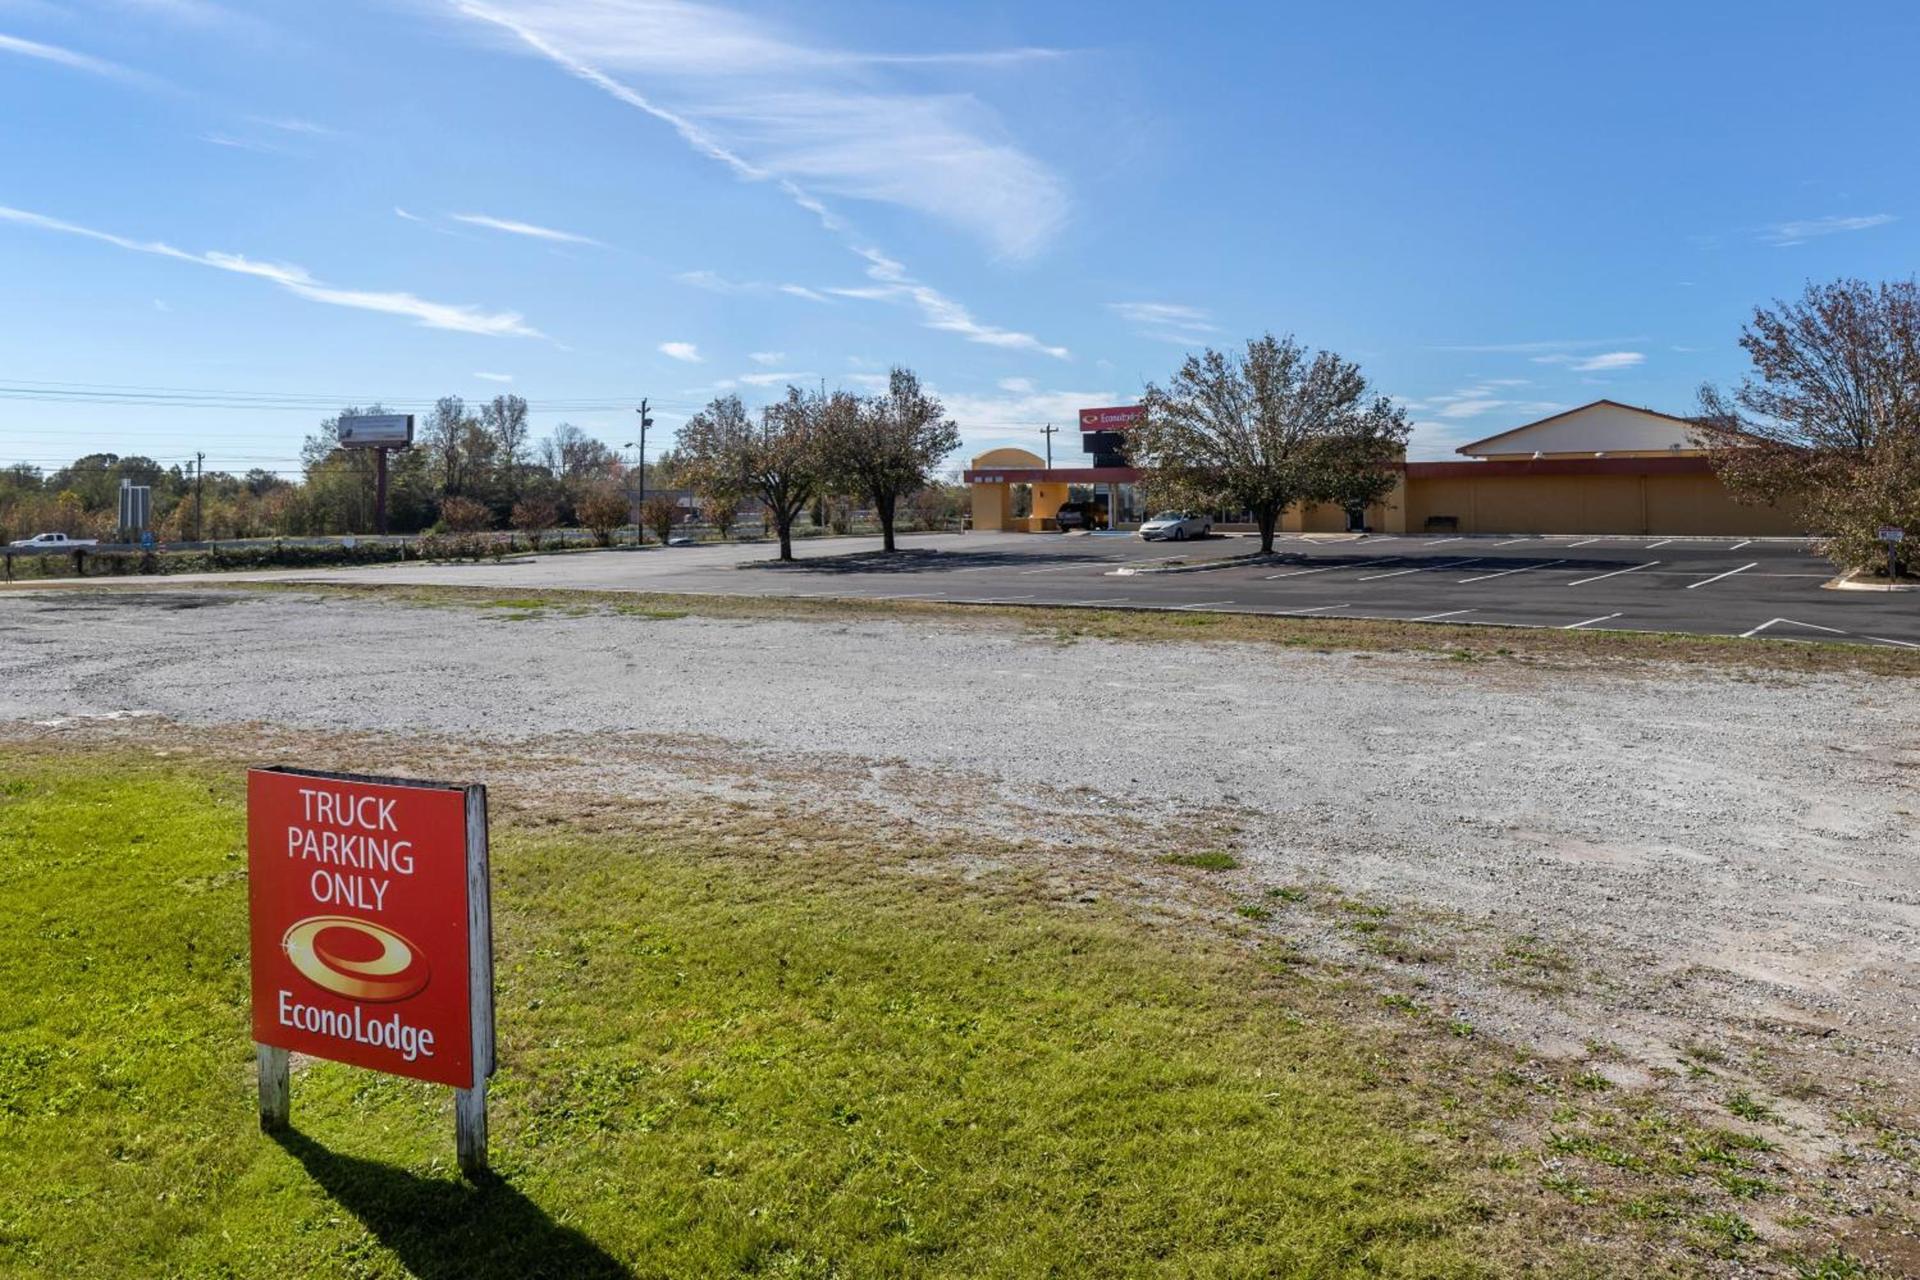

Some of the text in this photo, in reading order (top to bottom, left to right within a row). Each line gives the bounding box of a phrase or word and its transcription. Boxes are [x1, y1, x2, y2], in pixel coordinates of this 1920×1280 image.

[299, 788, 398, 832] TRUCK
[288, 827, 414, 874] PARKING
[311, 870, 389, 911] ONLY
[278, 990, 435, 1060] EconoLodge
